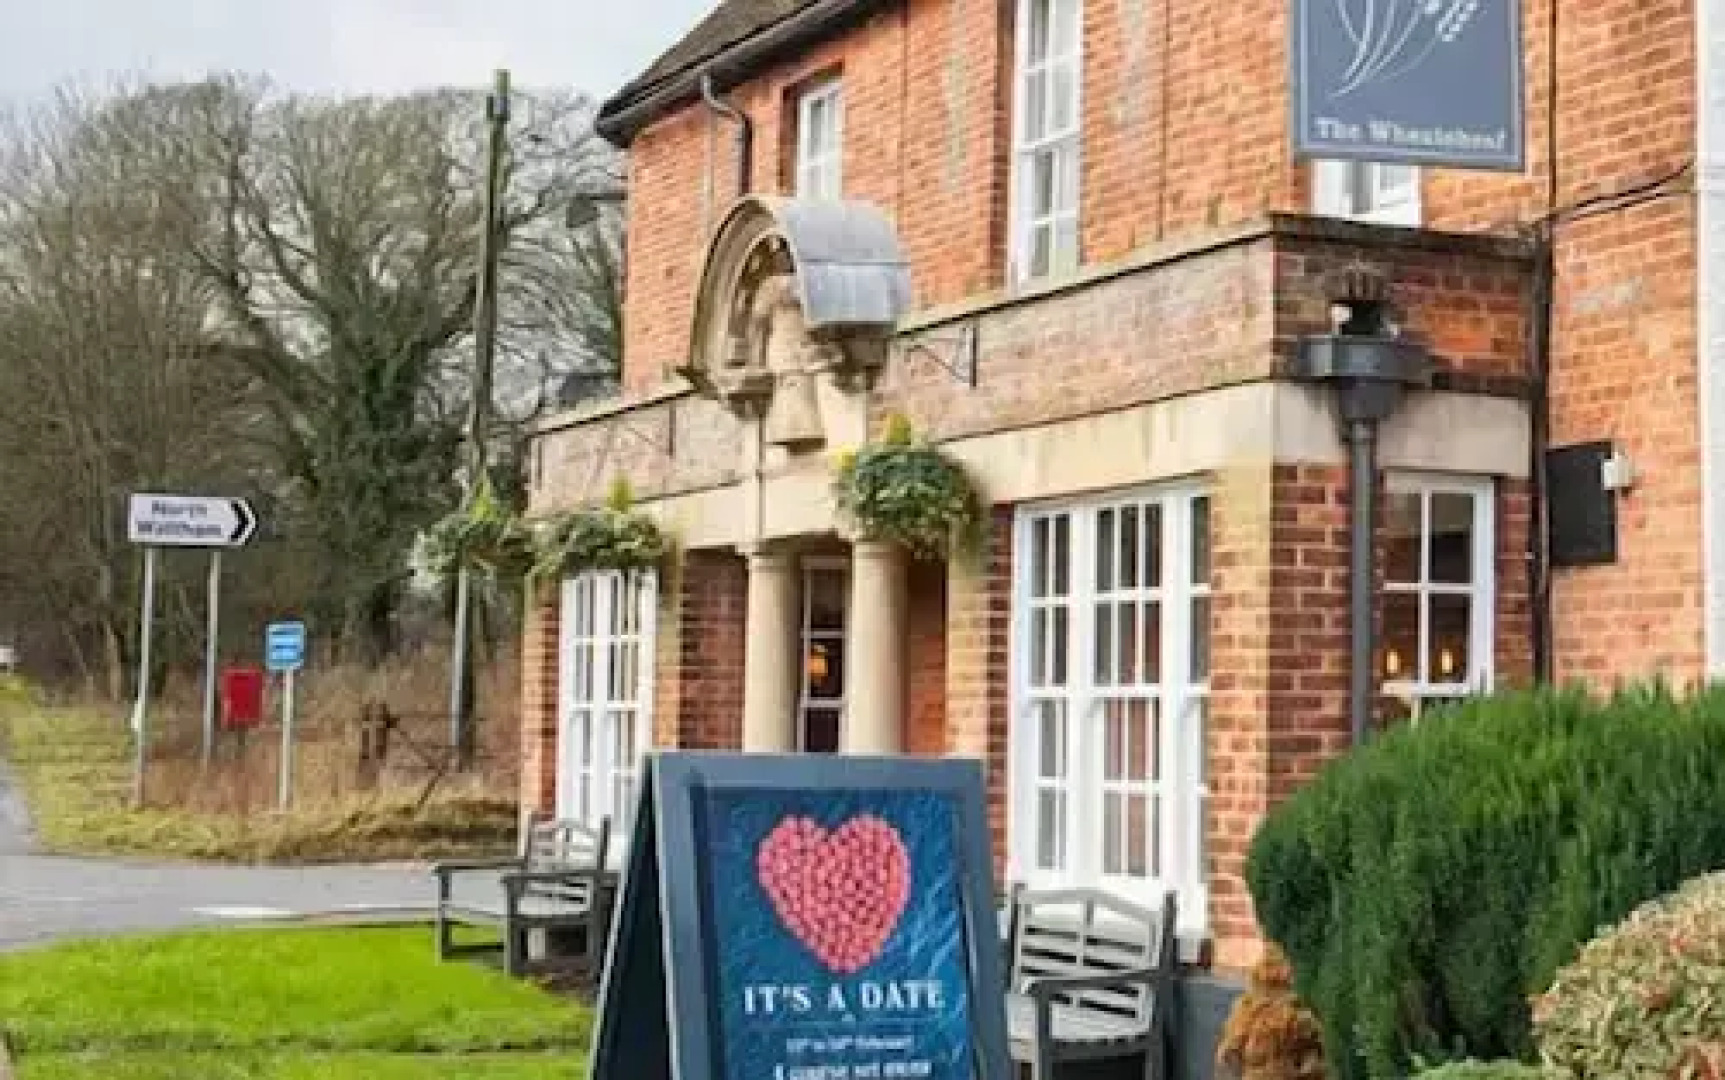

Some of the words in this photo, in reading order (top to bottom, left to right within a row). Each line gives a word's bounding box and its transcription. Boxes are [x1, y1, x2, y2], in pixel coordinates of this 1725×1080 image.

[1314, 116, 1361, 139] The
[151, 499, 208, 518] North
[744, 984, 812, 1014] IT'S
[827, 982, 846, 1011] A
[859, 980, 946, 1010] DATE
